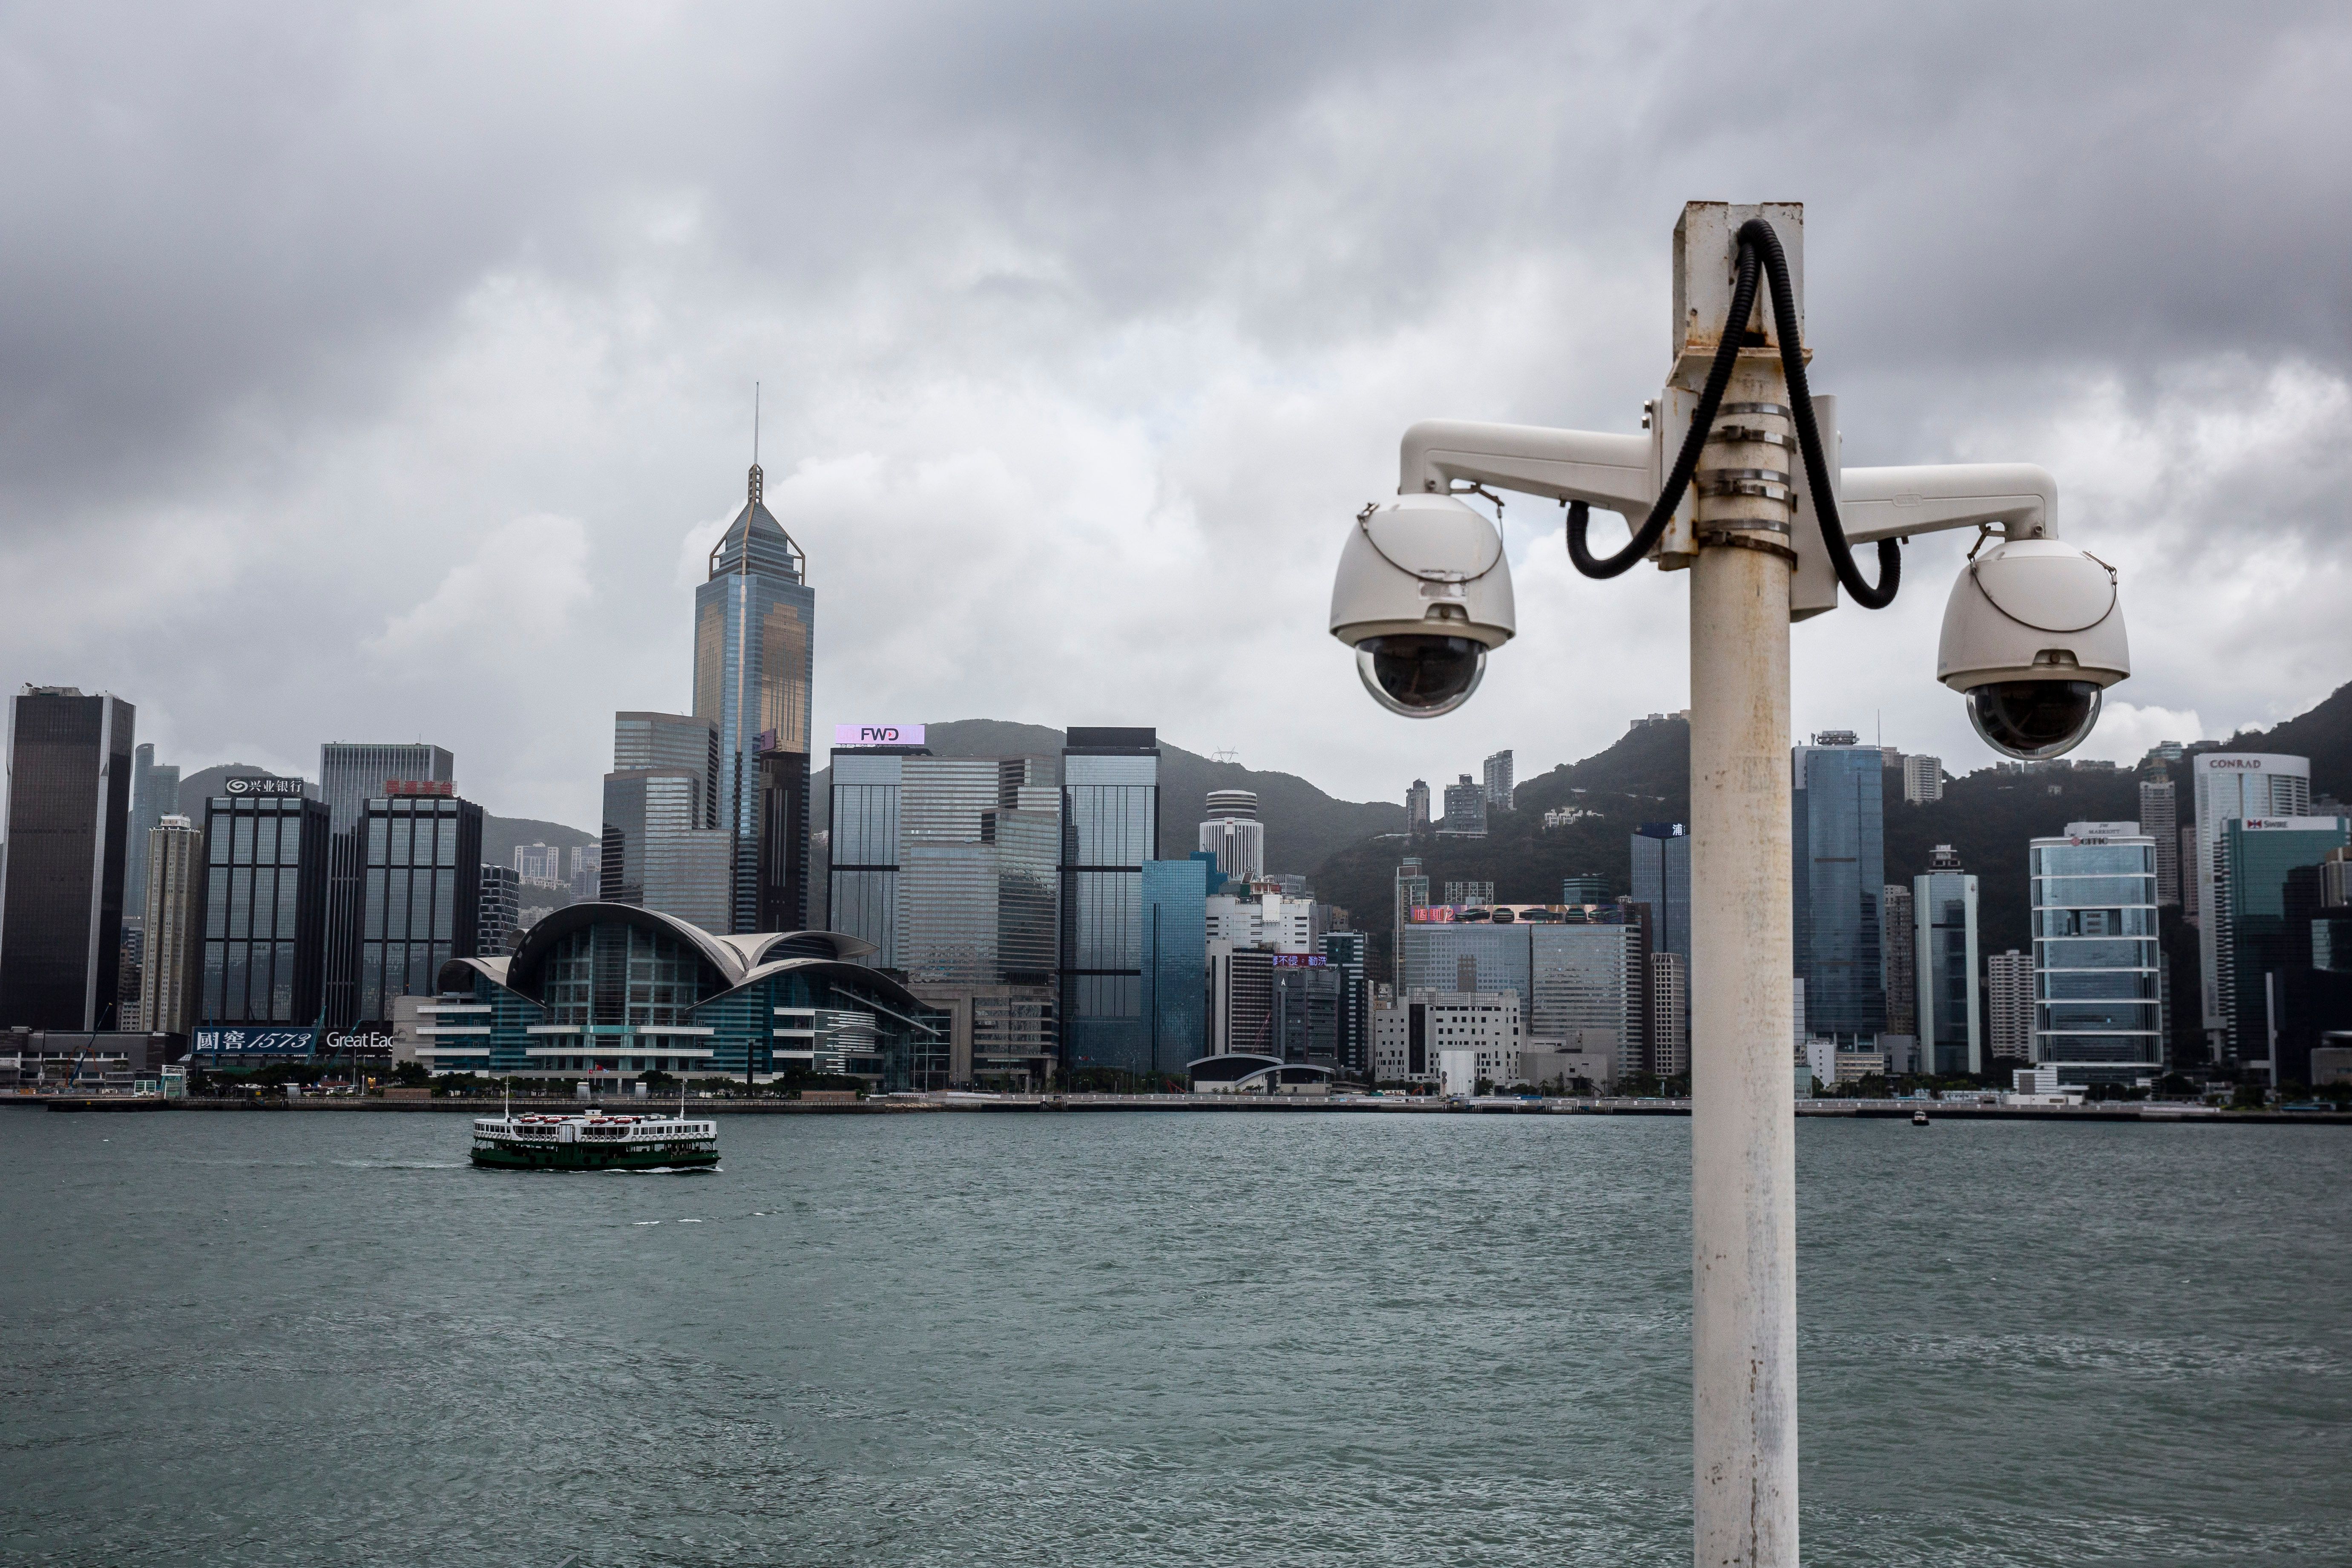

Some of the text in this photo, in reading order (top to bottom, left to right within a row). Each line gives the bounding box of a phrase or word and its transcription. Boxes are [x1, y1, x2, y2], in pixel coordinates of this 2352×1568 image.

[861, 728, 899, 740] FWD
[2209, 759, 2261, 768] CONRAD
[249, 780, 302, 792] 兴业银行
[326, 1032, 368, 1047] Great
